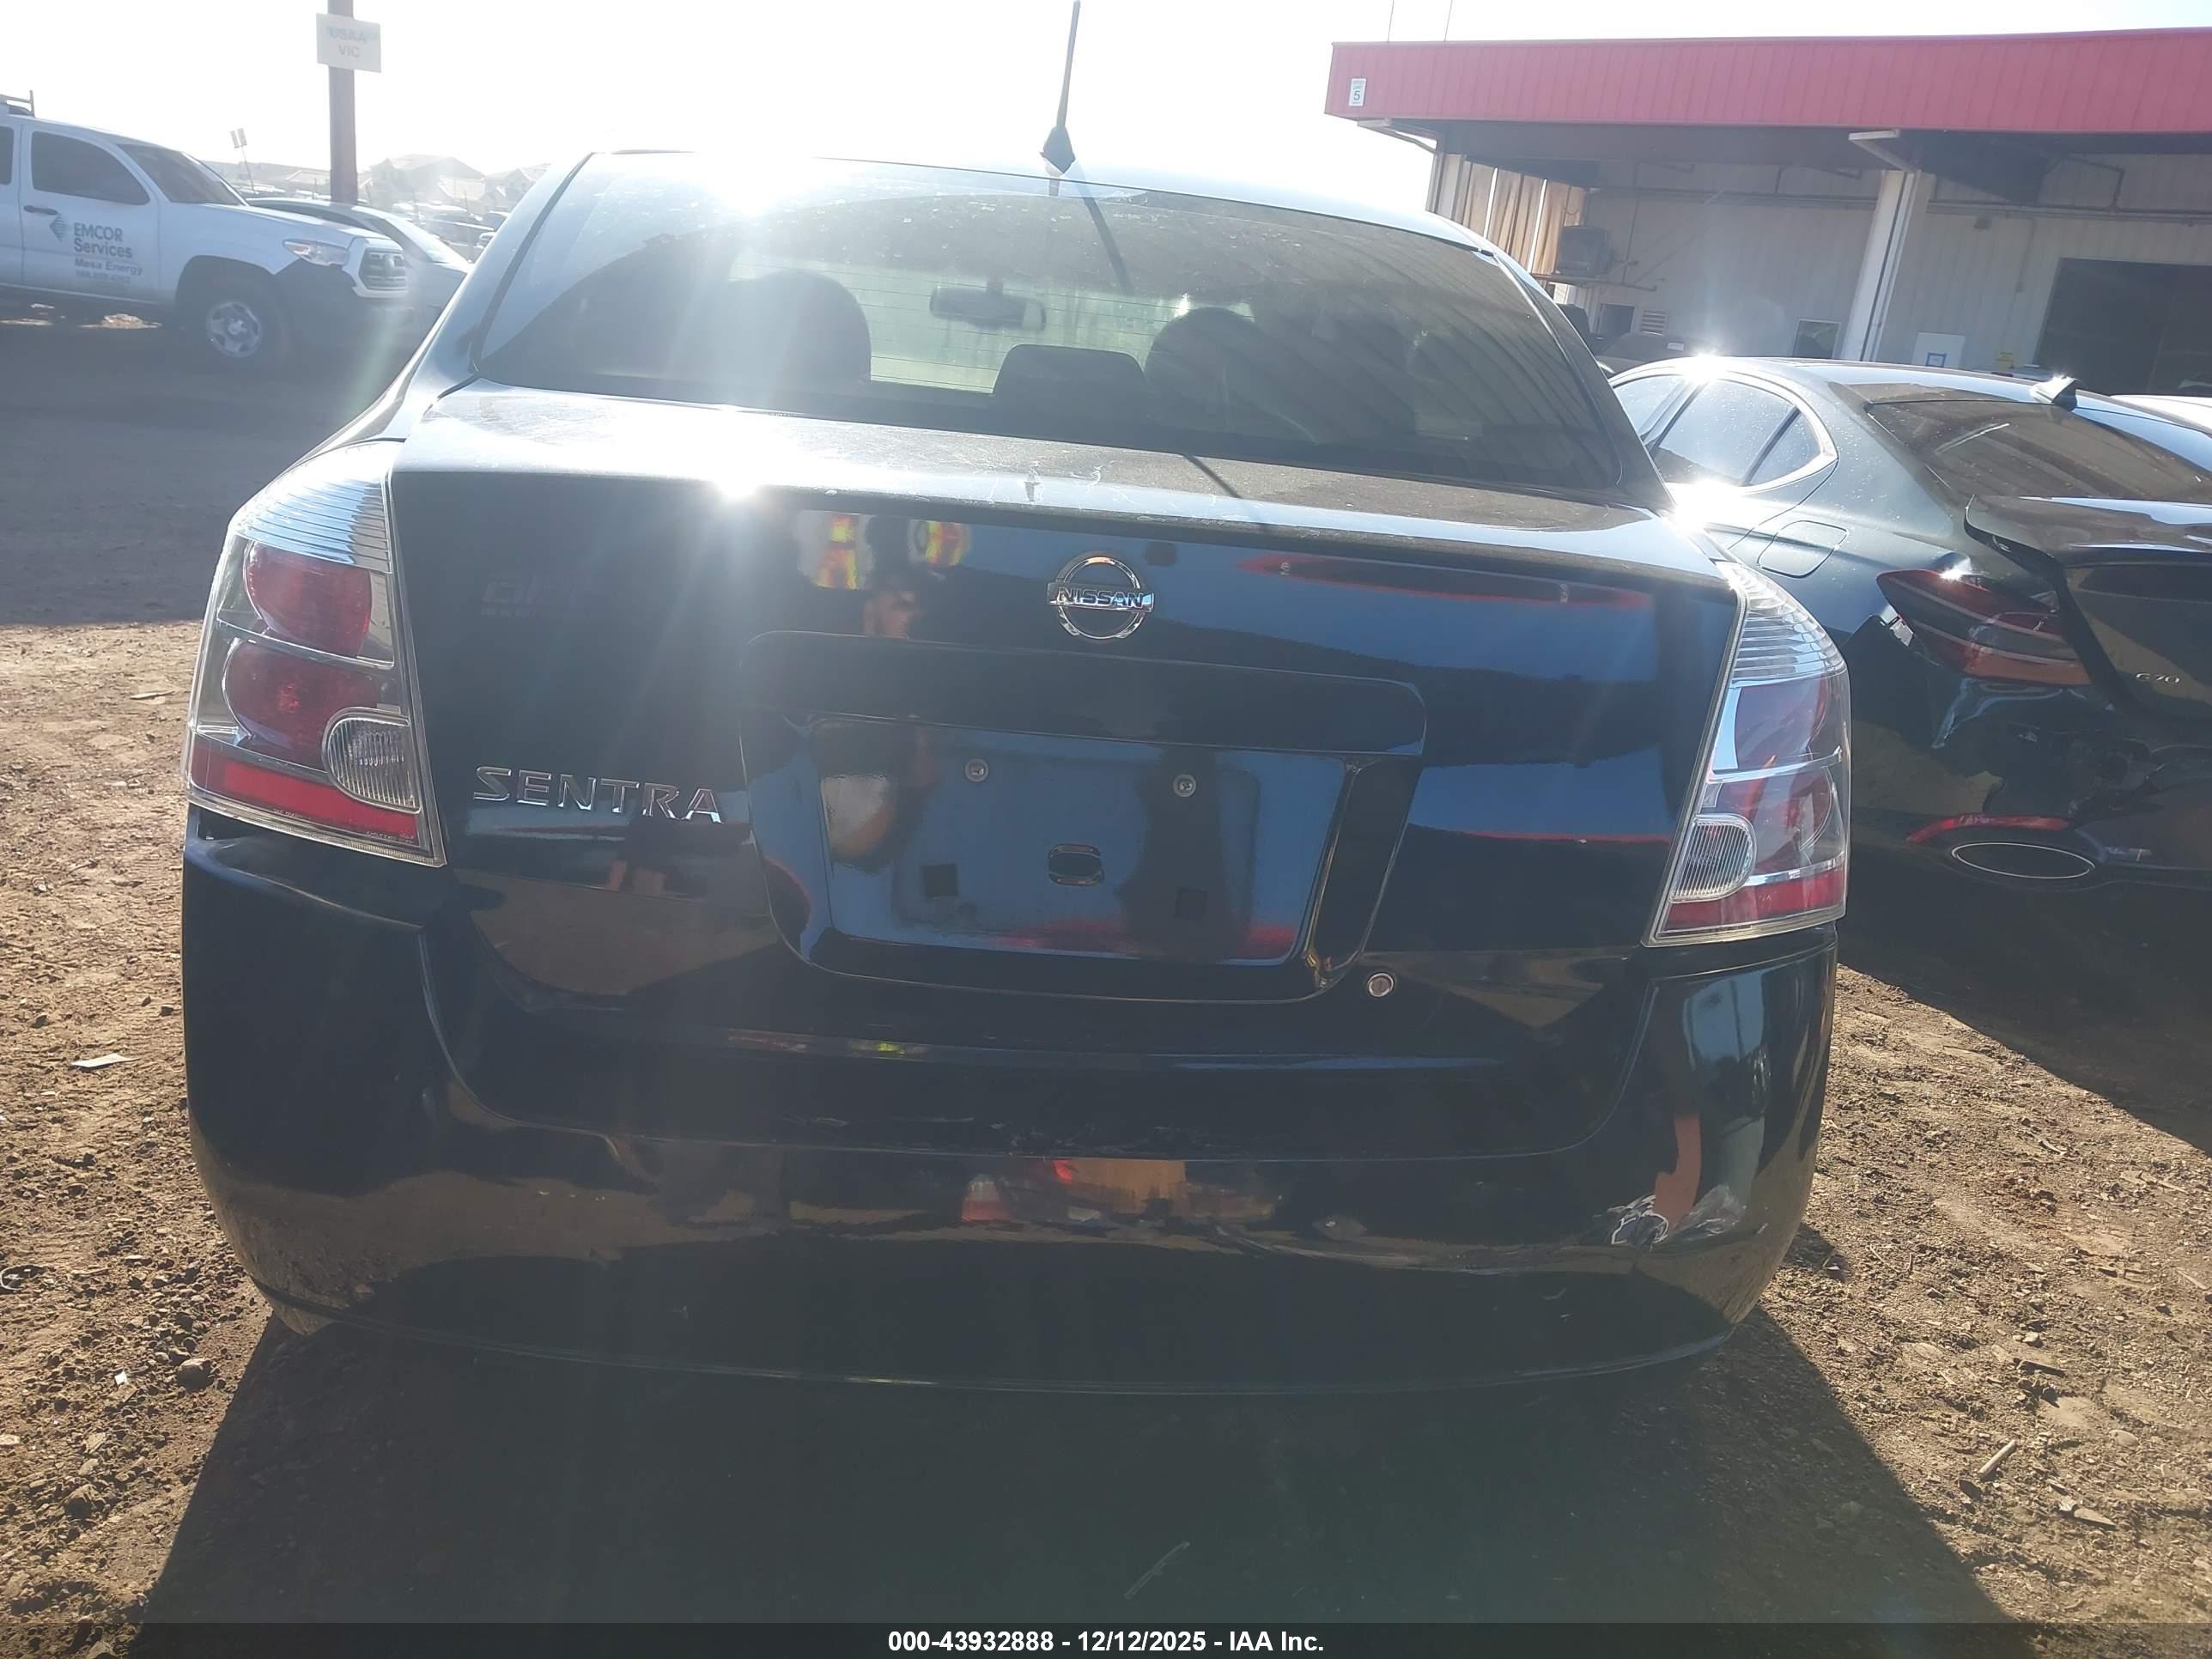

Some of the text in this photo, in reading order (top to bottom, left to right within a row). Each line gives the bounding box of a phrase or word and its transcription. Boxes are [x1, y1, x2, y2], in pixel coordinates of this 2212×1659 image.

[337, 43, 360, 58] VIC
[1353, 90, 1361, 101] 5
[74, 222, 124, 242] EMCOR
[74, 237, 133, 259] Services
[106, 261, 143, 276] Energy
[1057, 586, 1145, 608] NISSAN
[473, 765, 722, 823] SENTRA
